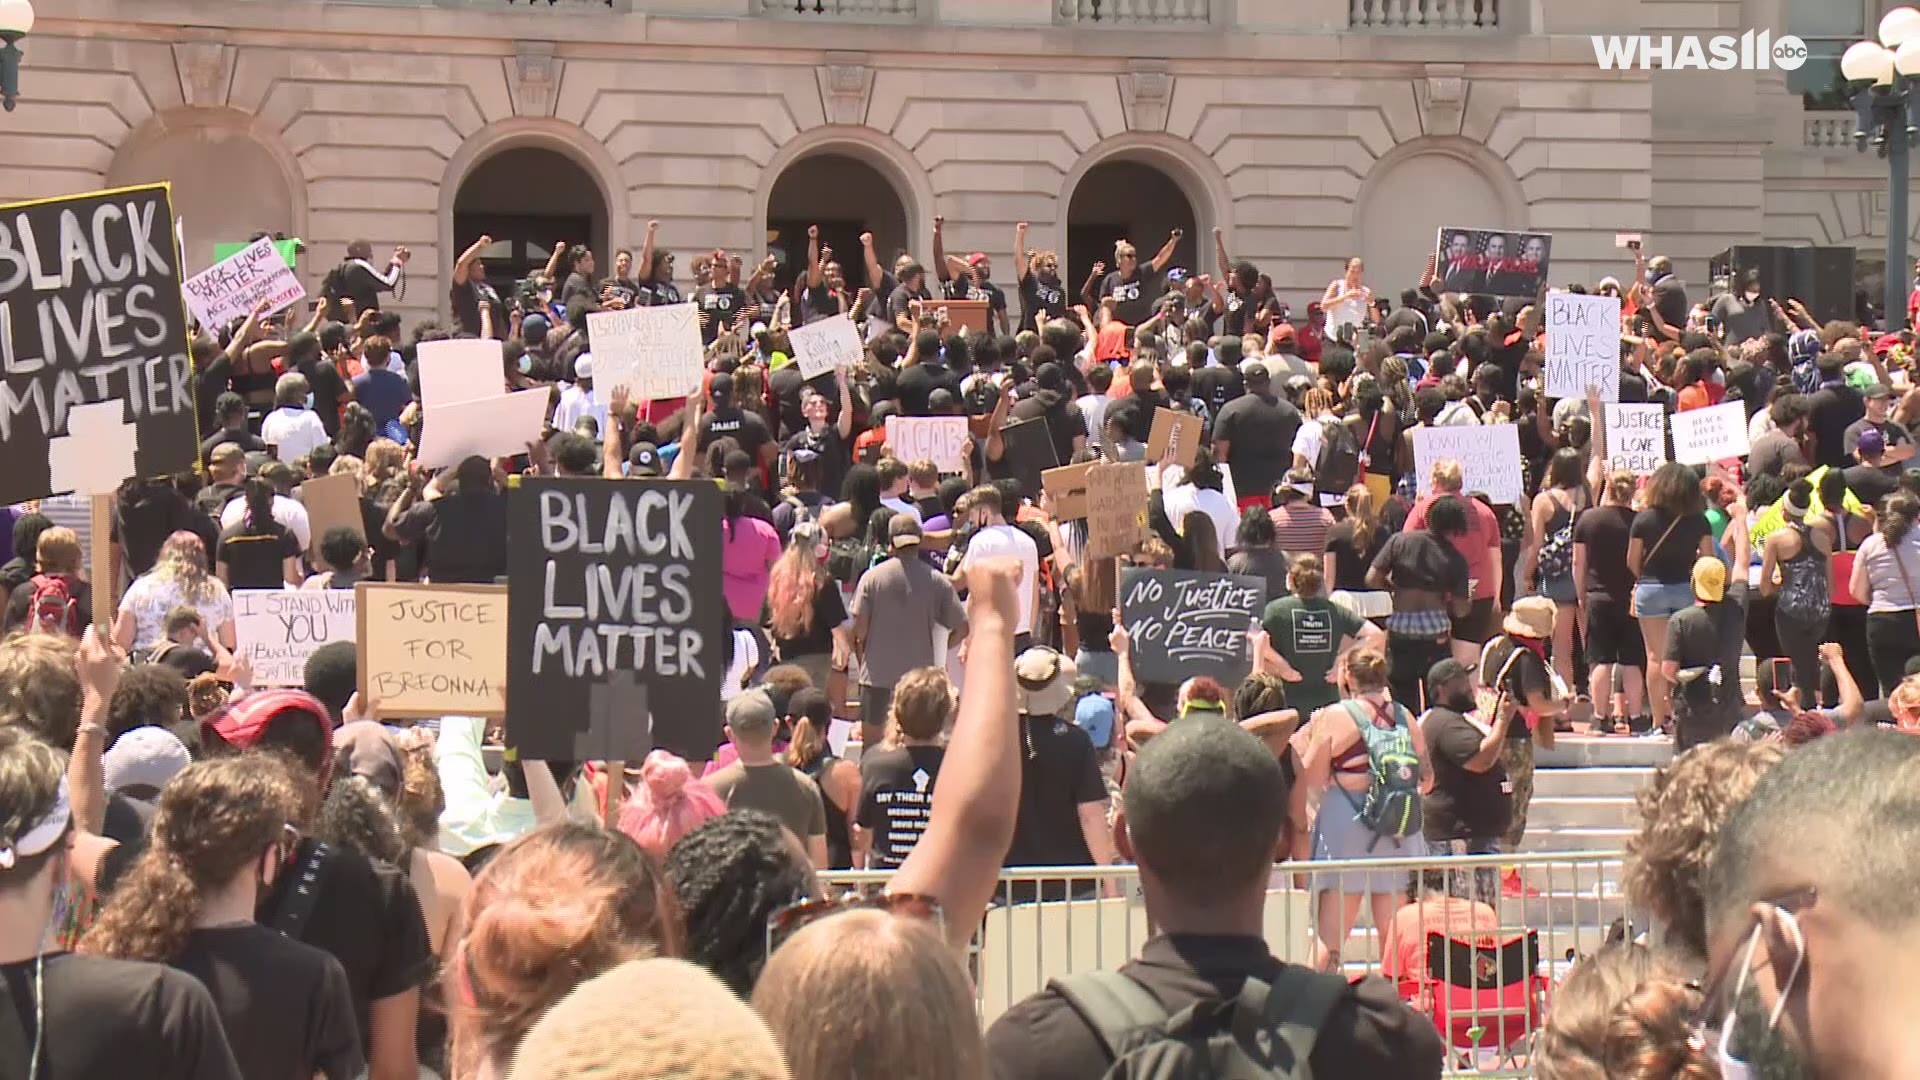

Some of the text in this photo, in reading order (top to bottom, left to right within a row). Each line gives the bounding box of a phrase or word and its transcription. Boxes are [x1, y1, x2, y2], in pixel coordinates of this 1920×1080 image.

[0, 201, 169, 294] BLACK
[187, 266, 230, 296] BLACK
[233, 243, 271, 270] LIVES
[203, 263, 264, 301] MATTER
[0, 285, 167, 374] LIVES
[1553, 298, 1613, 329] BLACK
[1553, 333, 1614, 360] LIVES
[1547, 359, 1614, 395] MATTER
[0, 353, 193, 442] MATTER
[1612, 408, 1661, 429] JUSTICE
[1621, 437, 1655, 452] LOVE
[540, 489, 695, 561] BLACK
[238, 594, 257, 616] I
[266, 593, 322, 615] STAND
[543, 559, 692, 624] LIVES
[1125, 578, 1163, 607] NO
[278, 614, 328, 643] YOU
[389, 600, 496, 624] JUSTICE
[404, 639, 473, 660] FOR
[532, 622, 705, 679] MATTER
[1129, 617, 1248, 652] NO PEACE
[372, 671, 490, 699] BREONNA
